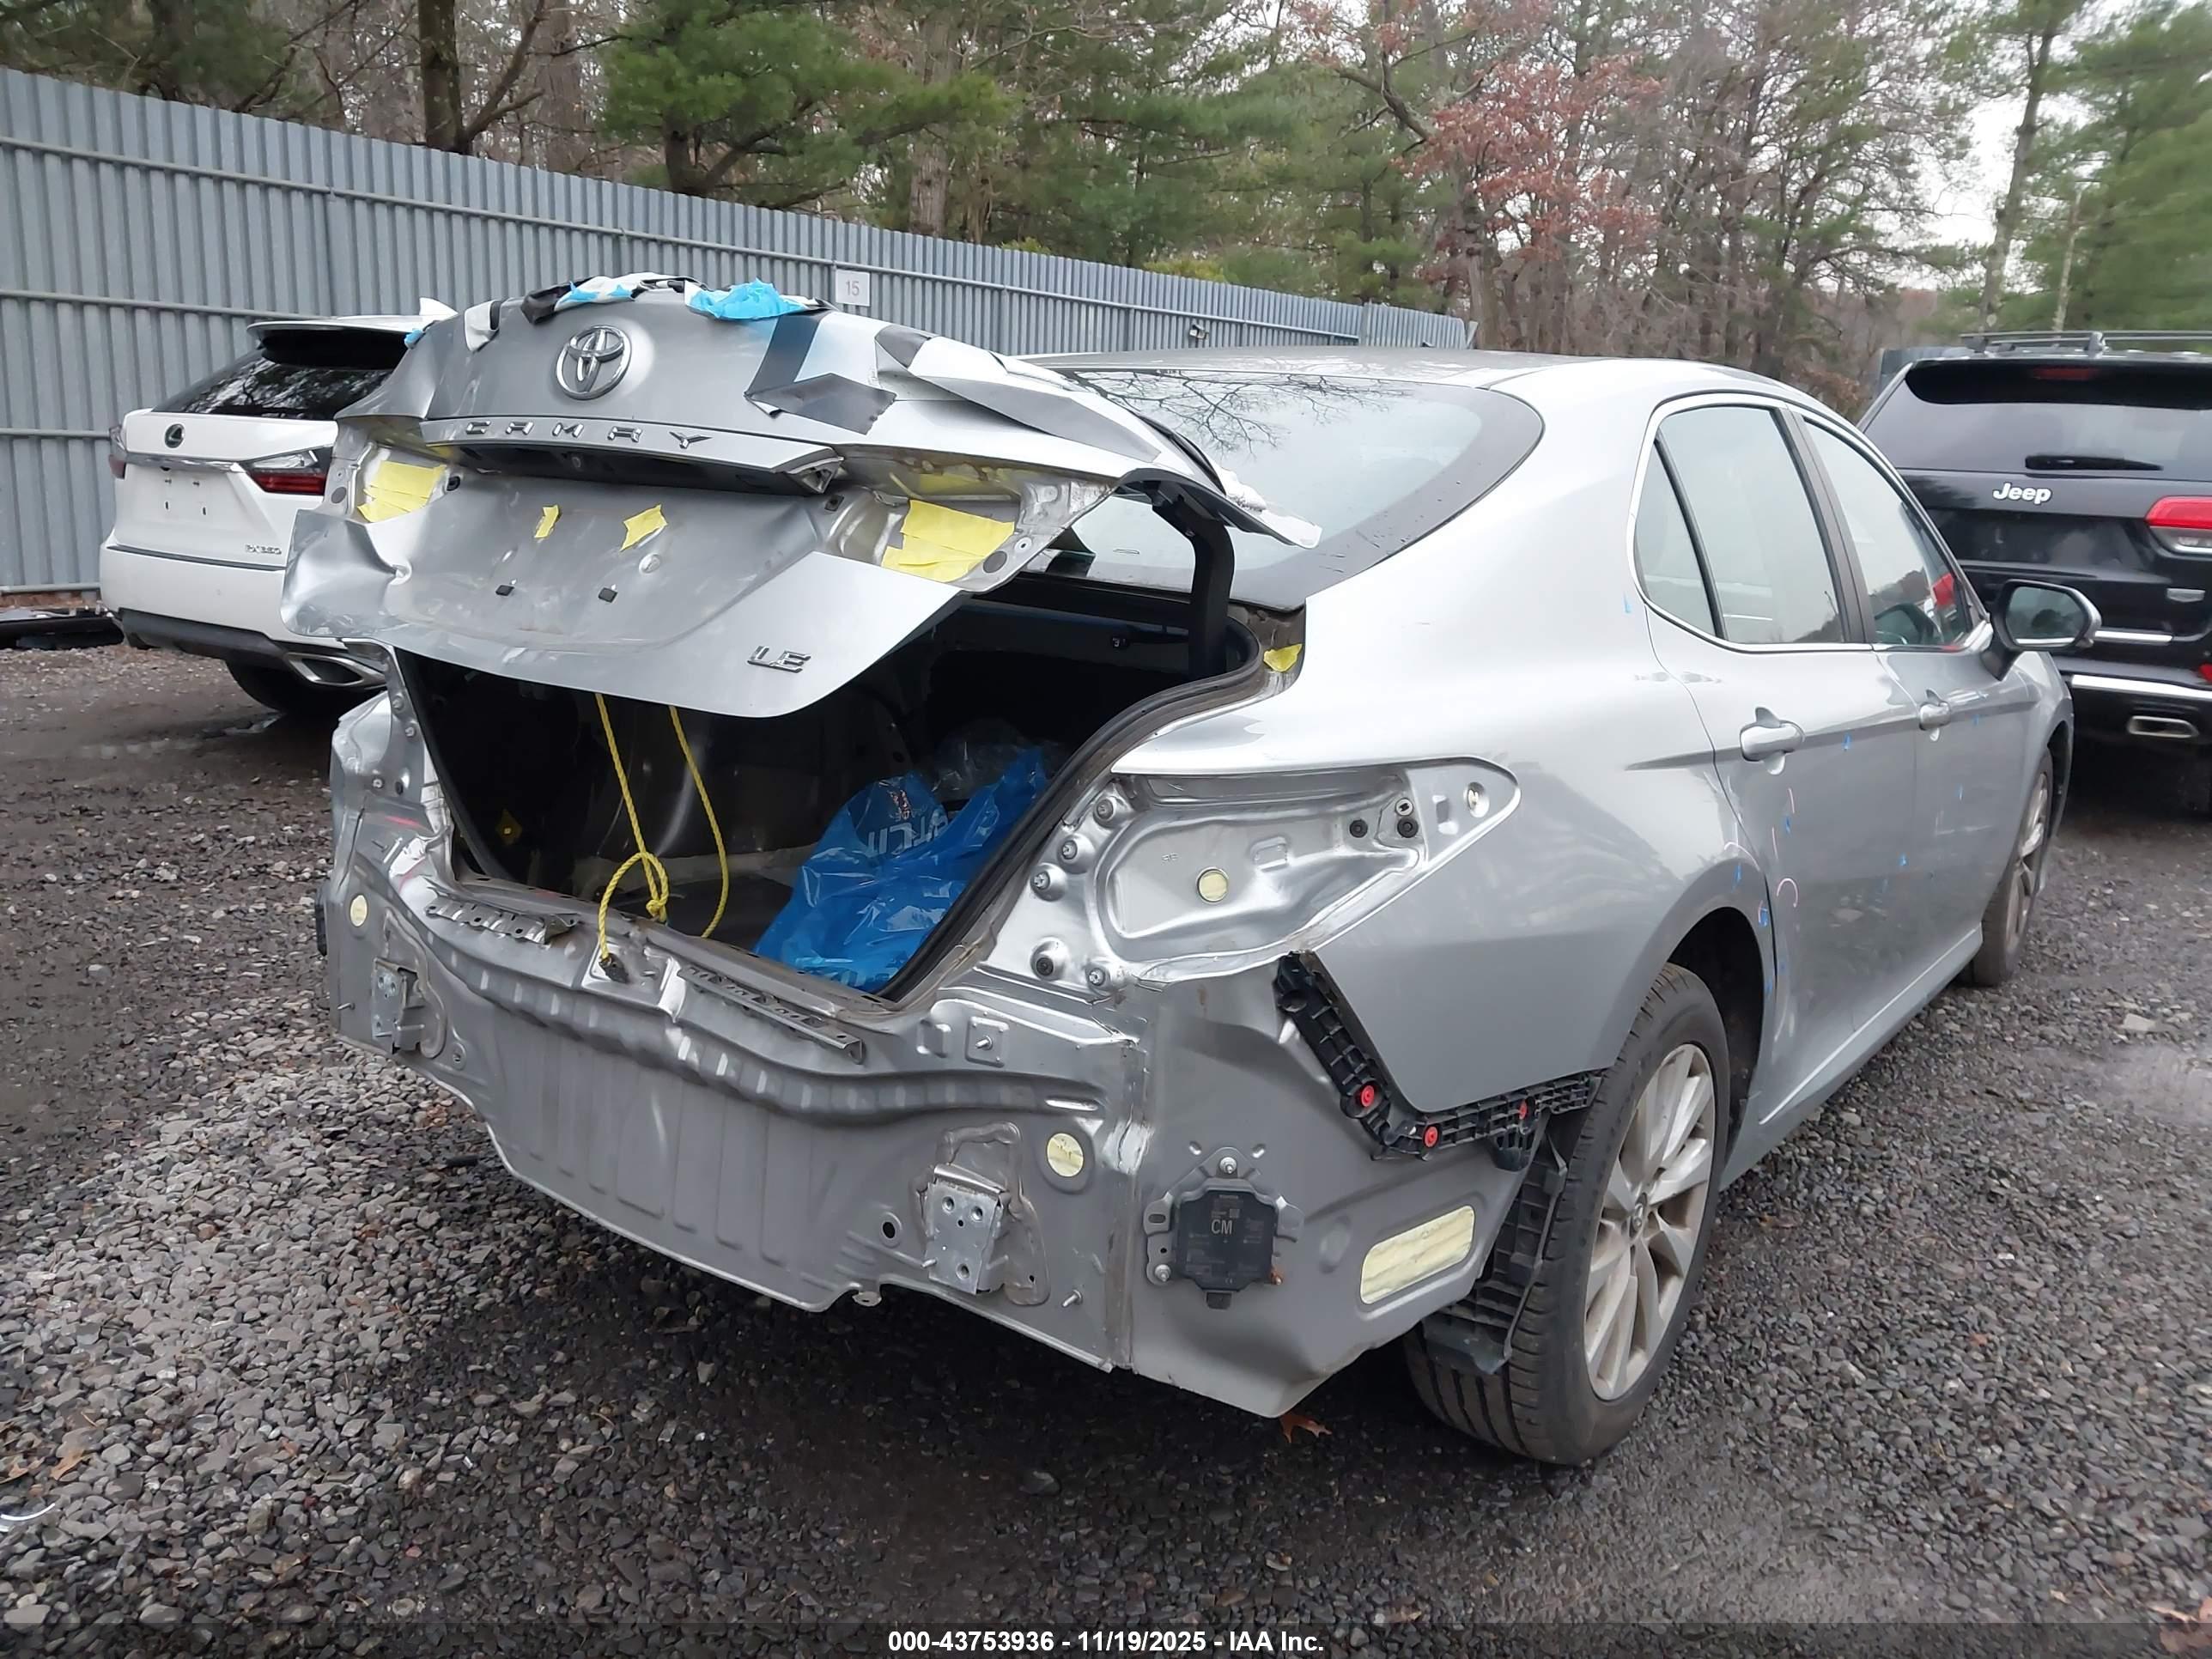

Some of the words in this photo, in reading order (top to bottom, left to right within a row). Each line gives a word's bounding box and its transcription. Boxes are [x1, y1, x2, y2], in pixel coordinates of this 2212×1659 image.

[845, 281, 860, 296] 15
[465, 420, 714, 449] CAMRY
[1992, 482, 2052, 505] Jeep
[746, 645, 811, 673] LE
[1211, 1218, 1233, 1234] CM
